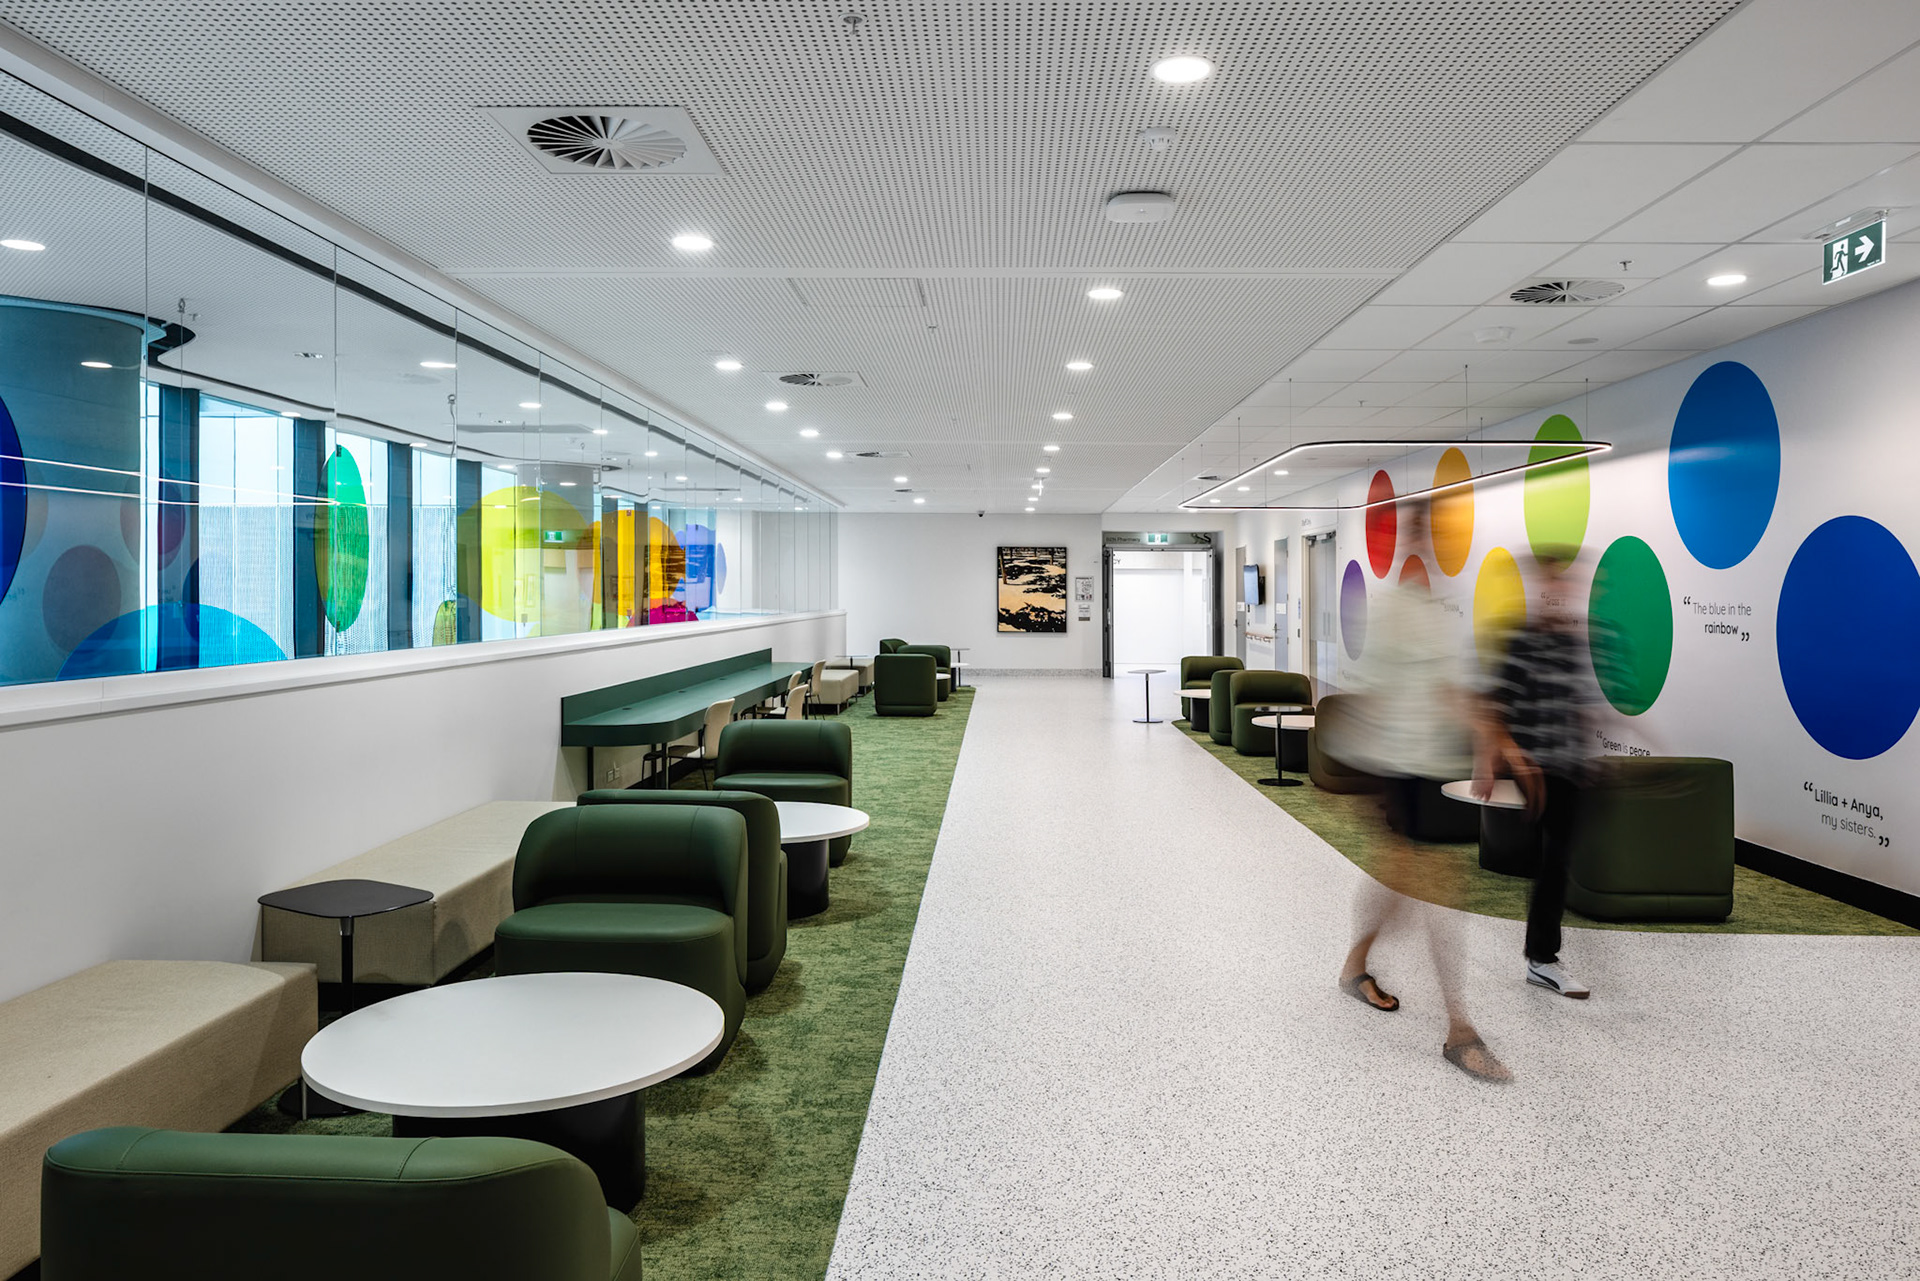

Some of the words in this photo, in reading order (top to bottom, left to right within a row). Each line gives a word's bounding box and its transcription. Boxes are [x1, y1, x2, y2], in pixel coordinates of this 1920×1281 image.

[1709, 602, 1726, 615] blue
[1728, 603, 1736, 616] in
[1738, 602, 1752, 616] the
[1622, 742, 1628, 754] is
[1841, 798, 1848, 808] +
[1850, 798, 1884, 821] Anya,
[1821, 814, 1838, 831] my
